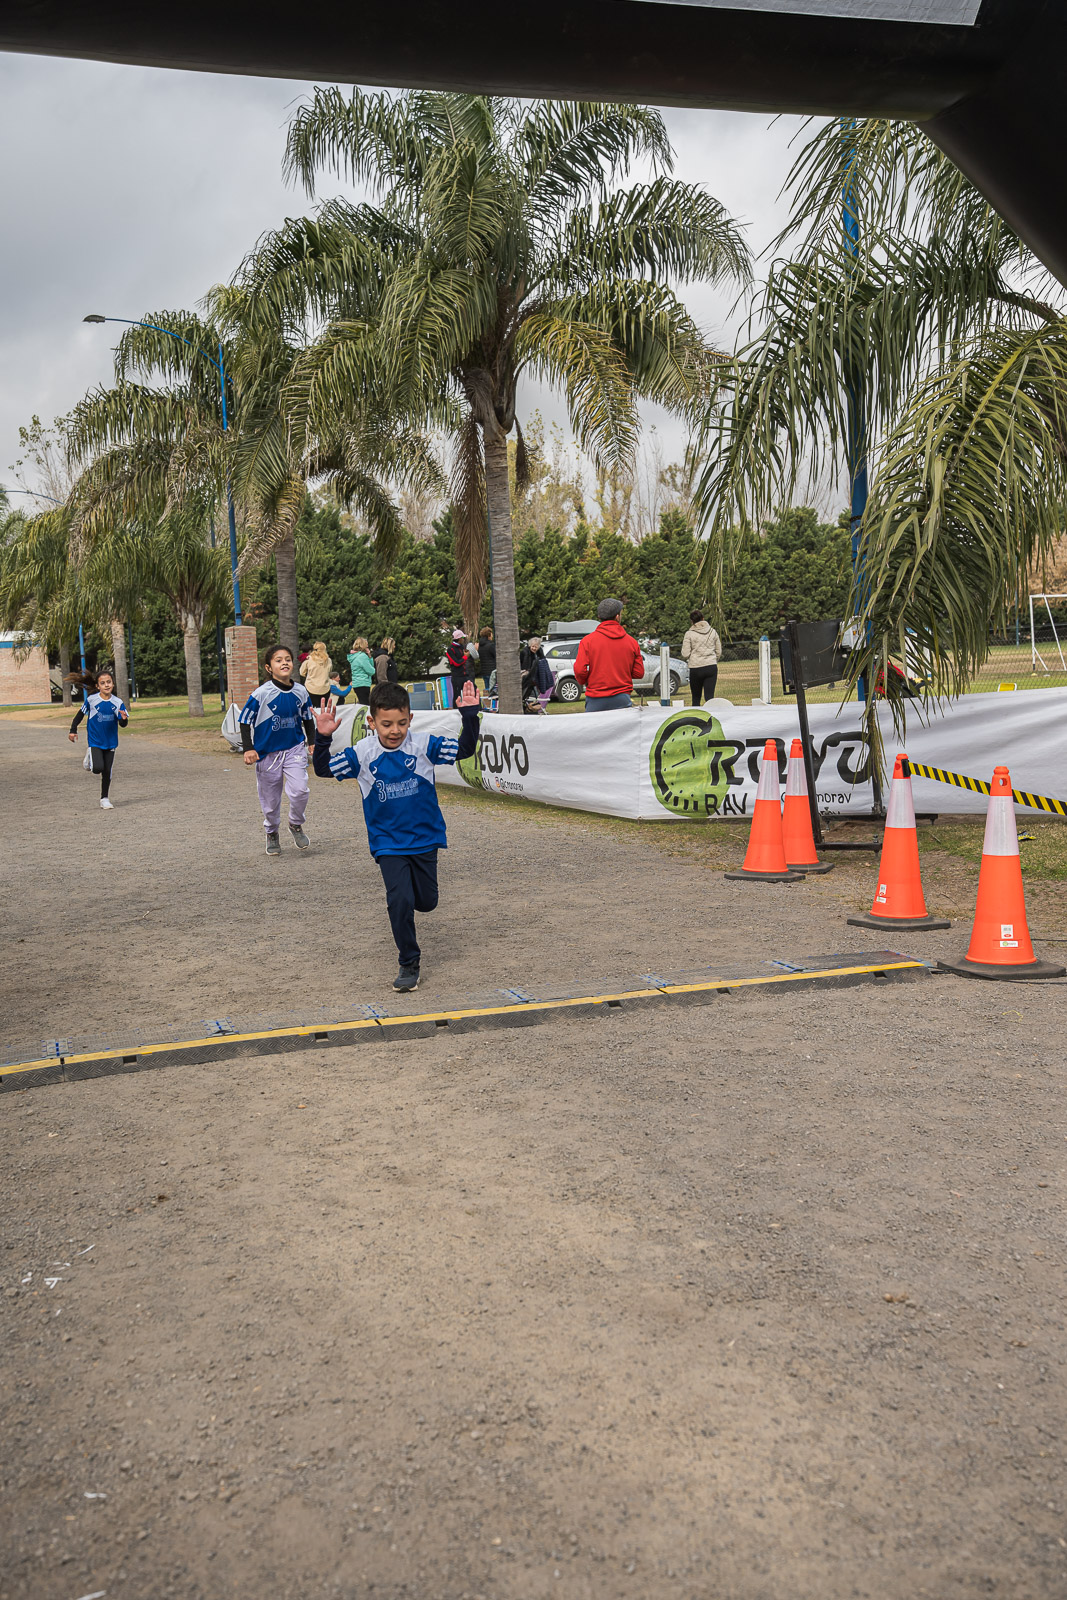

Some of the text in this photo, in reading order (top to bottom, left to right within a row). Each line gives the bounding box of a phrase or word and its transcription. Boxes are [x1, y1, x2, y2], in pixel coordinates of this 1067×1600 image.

[271, 715, 281, 731] 3
[474, 734, 529, 776] RONO
[376, 779, 387, 803] 3
